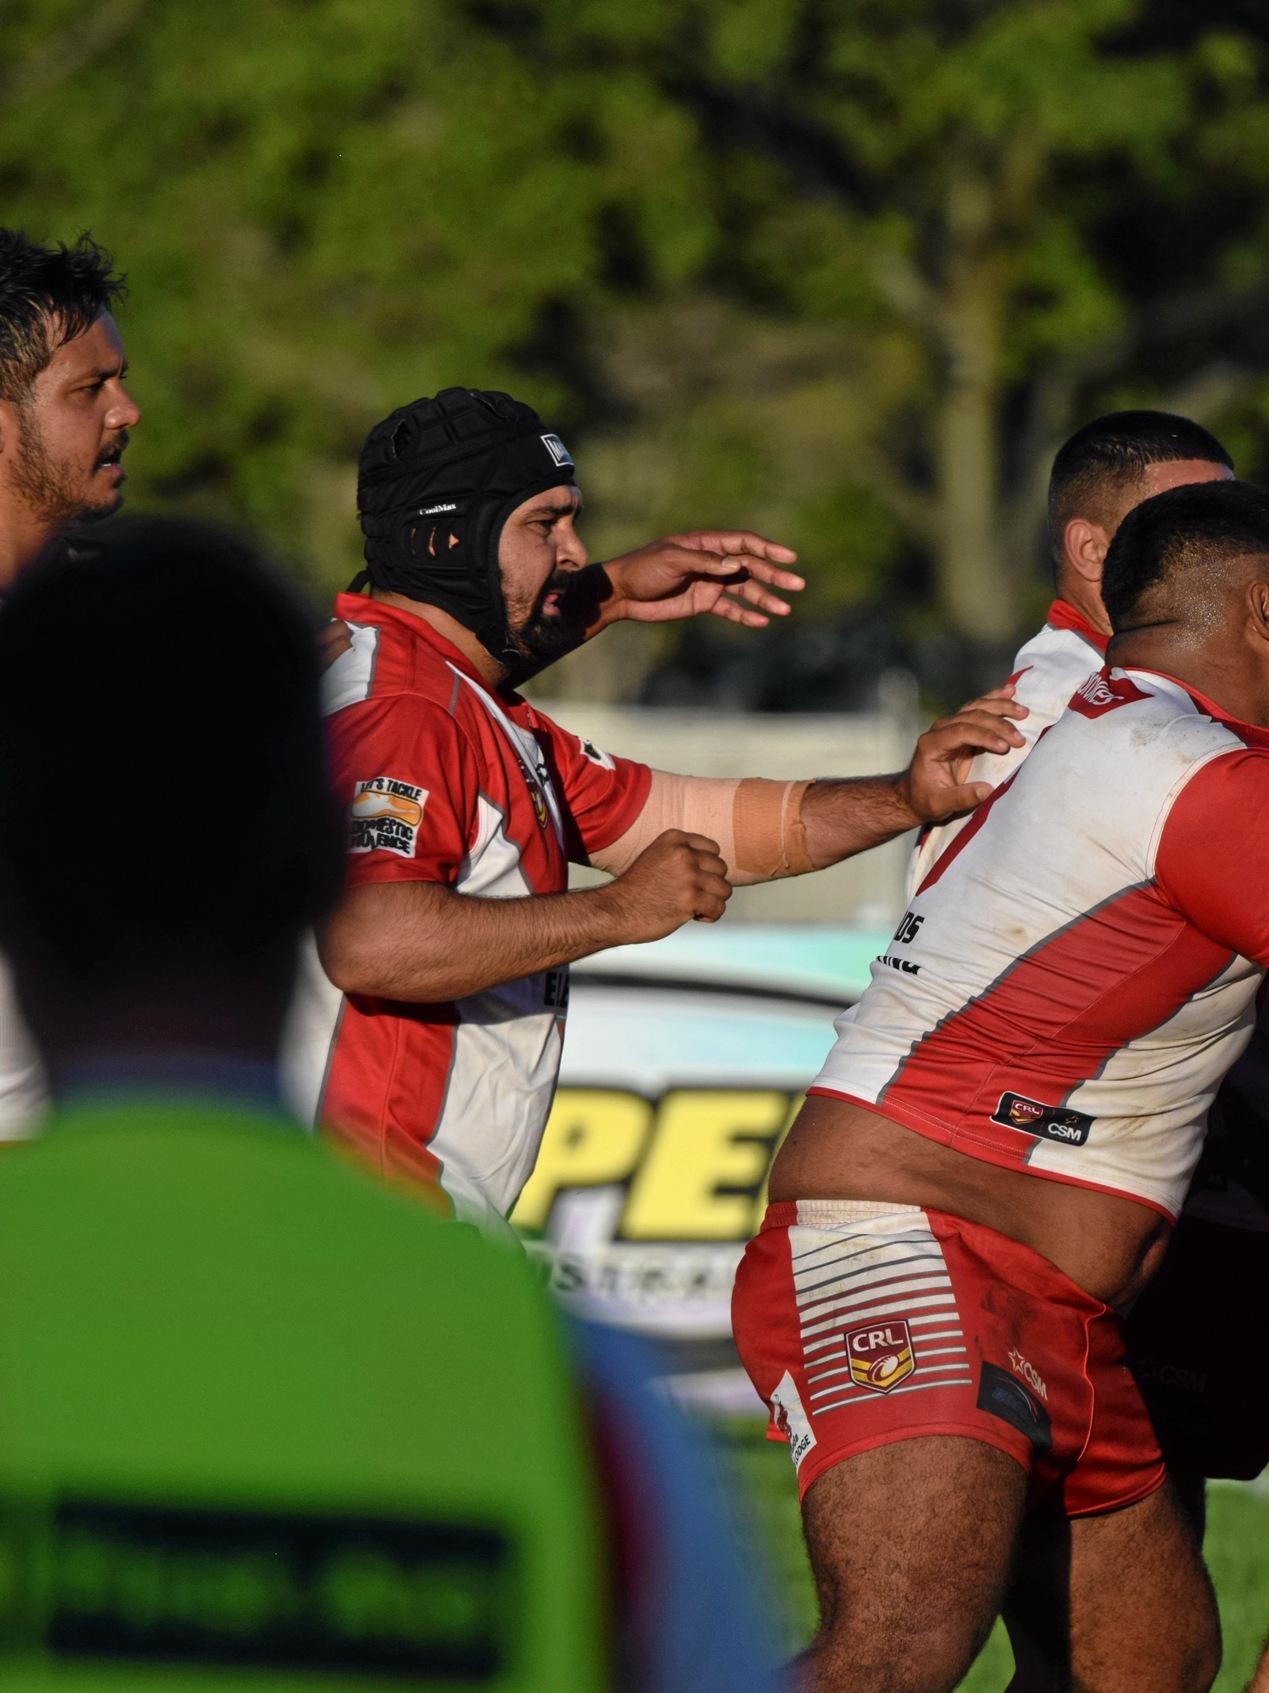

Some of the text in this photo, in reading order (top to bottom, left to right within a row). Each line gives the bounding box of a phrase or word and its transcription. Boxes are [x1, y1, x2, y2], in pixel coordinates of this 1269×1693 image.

[419, 502, 457, 516] CoolMax
[387, 779, 423, 801] TACKLE
[1015, 1103, 1040, 1114] CRL
[1048, 1123, 1082, 1141] CSM
[852, 1327, 904, 1353] CRL
[1023, 1362, 1049, 1401] CSM
